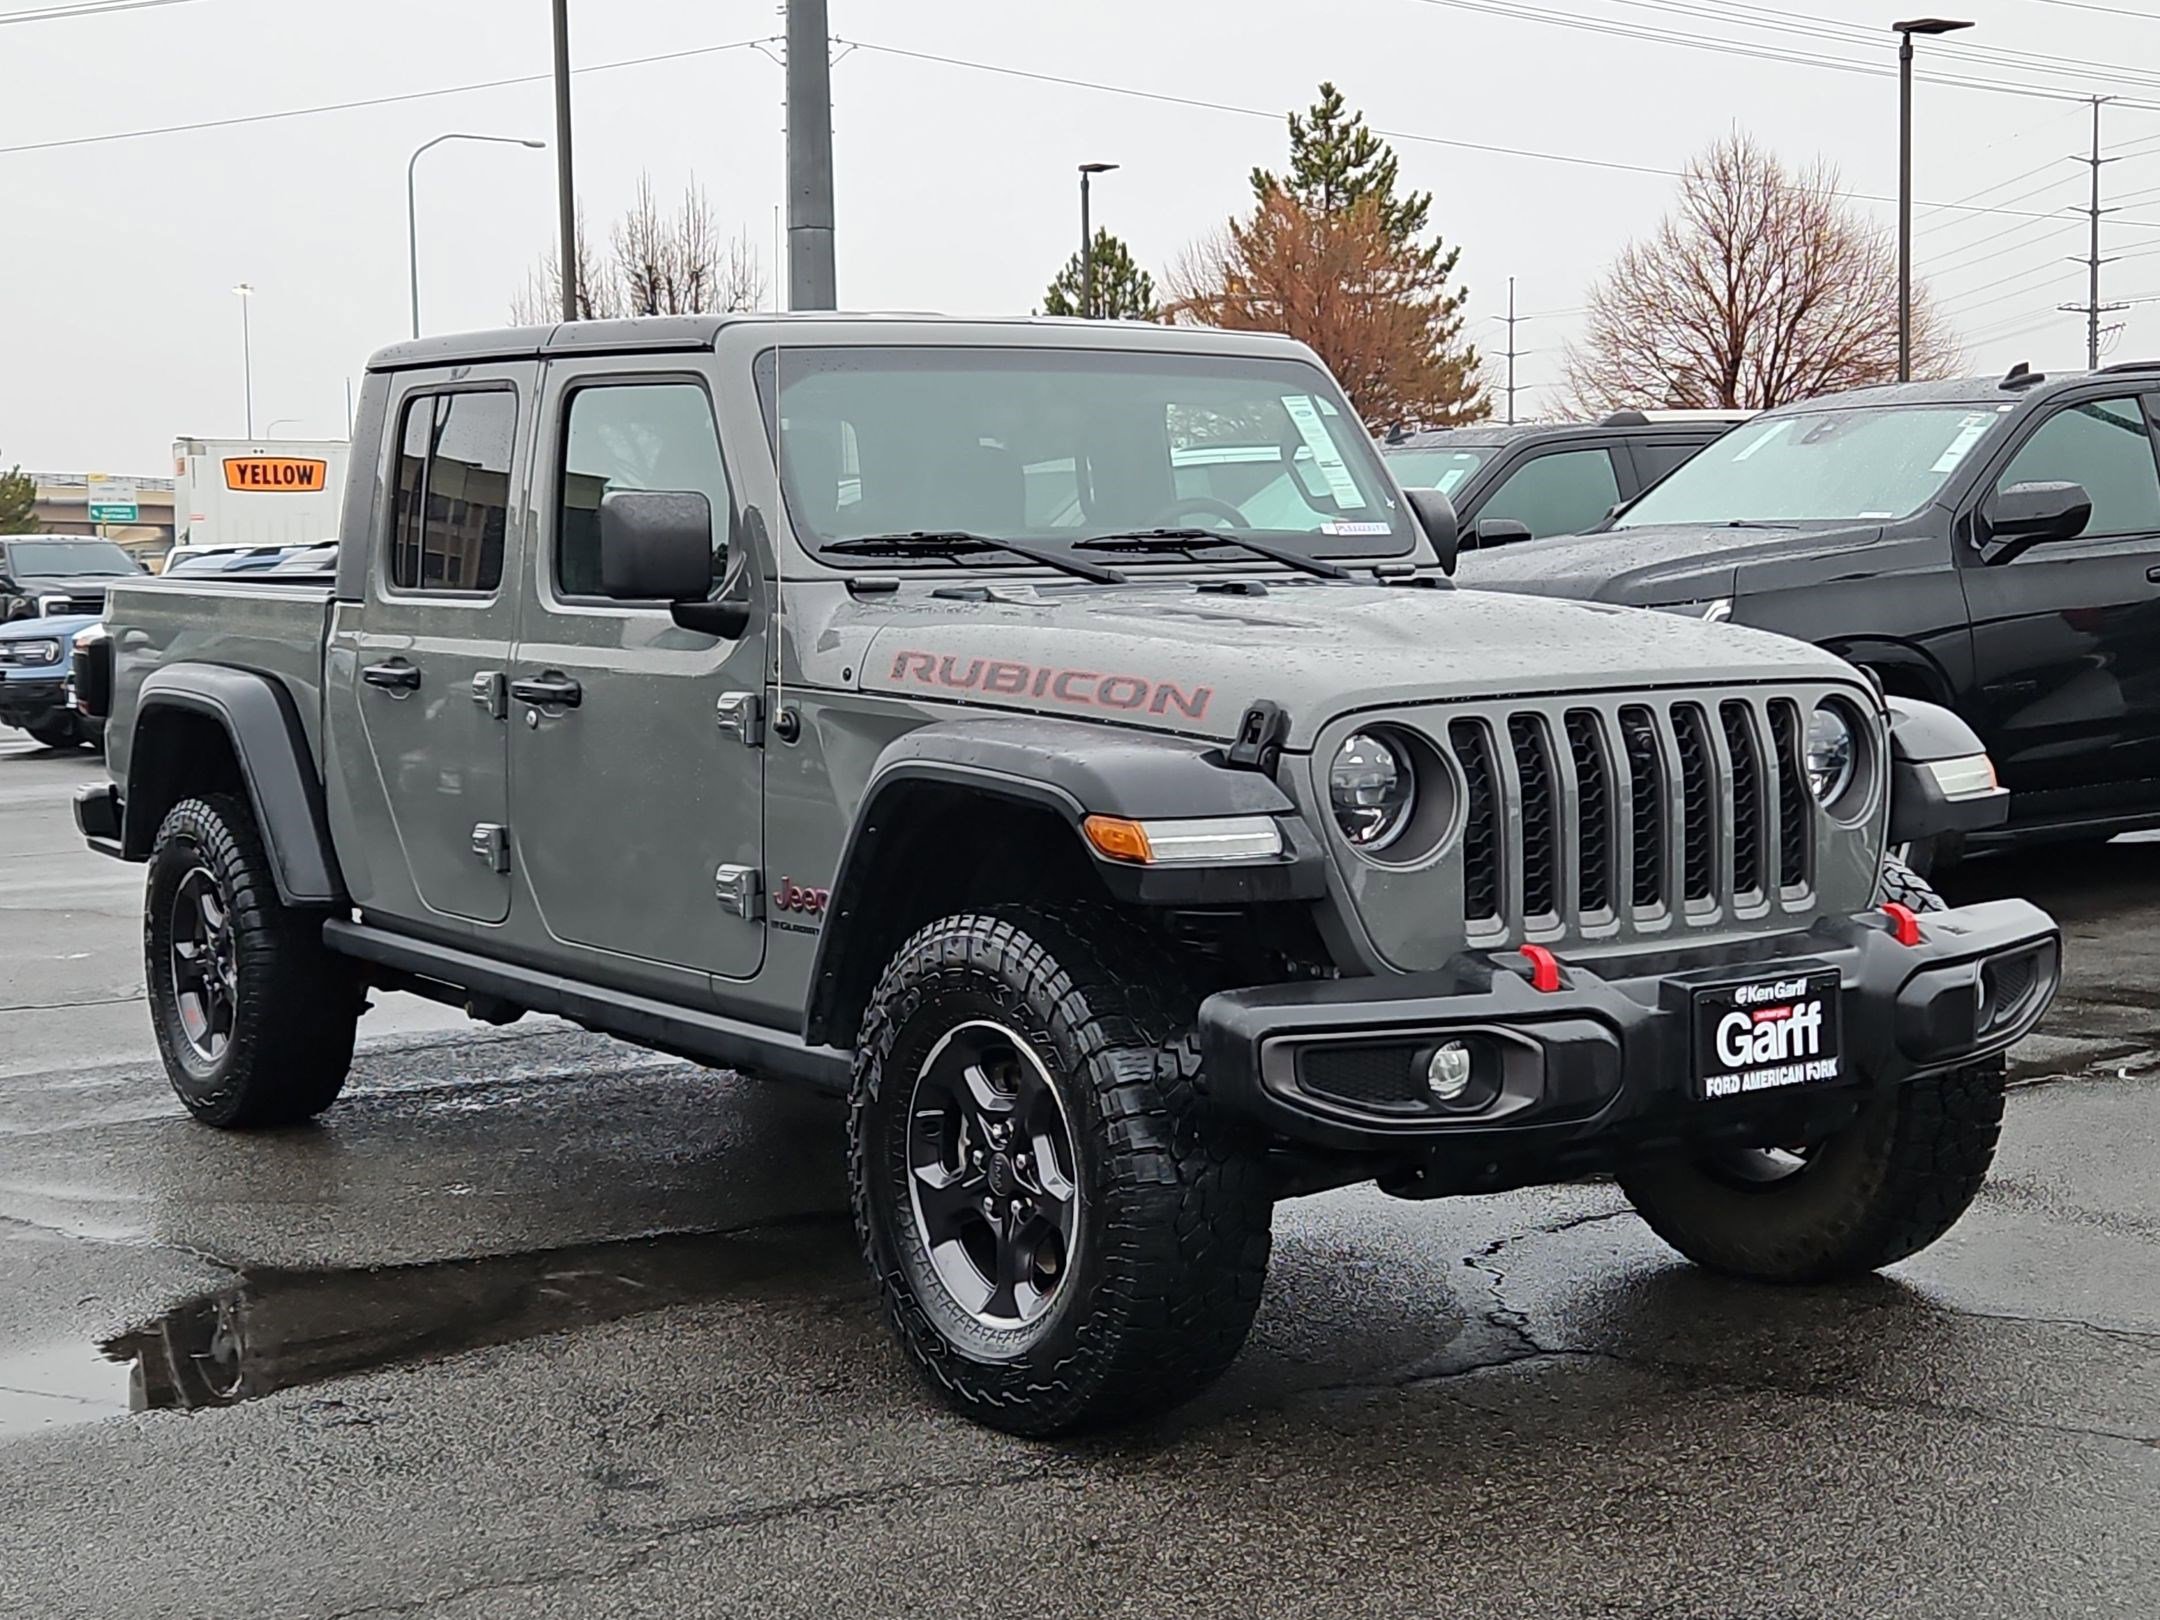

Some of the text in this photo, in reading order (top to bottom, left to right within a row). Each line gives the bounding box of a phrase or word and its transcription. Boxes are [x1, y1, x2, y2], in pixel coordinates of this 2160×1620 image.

[236, 463, 314, 486] YELLOW
[890, 649, 1215, 721] RUBICON
[772, 876, 829, 923] Jeep
[1716, 1000, 1822, 1068] Garff
[1705, 1057, 1838, 1098] FORD AMERICAN FORK
